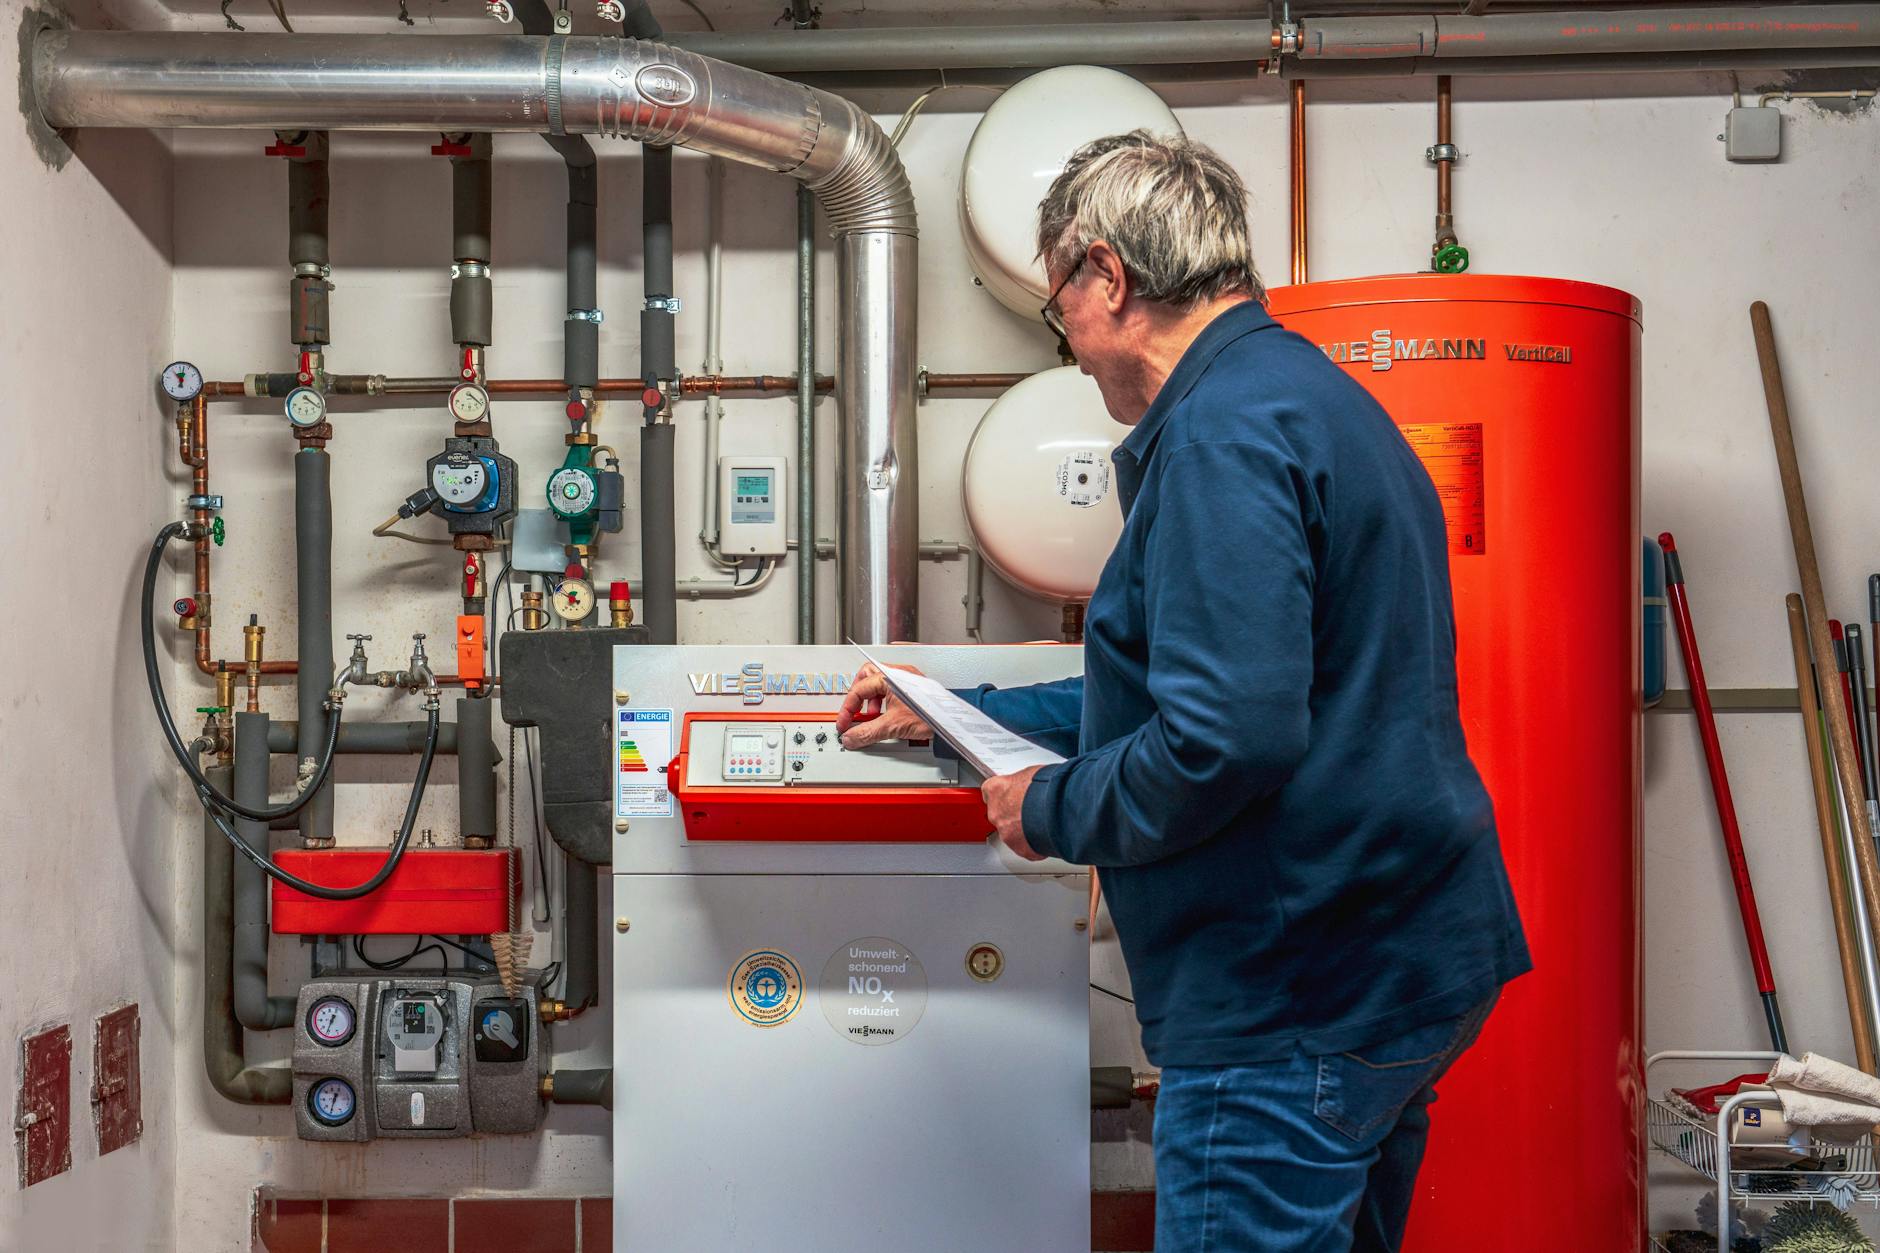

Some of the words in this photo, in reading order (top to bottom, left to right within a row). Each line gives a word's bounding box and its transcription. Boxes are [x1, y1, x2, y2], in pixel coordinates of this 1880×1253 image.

[1319, 330, 1486, 372] VIESSMANN
[1504, 343, 1572, 363] VertiCell
[849, 947, 900, 959] Umwelt-
[848, 961, 906, 973] schonend
[847, 1005, 900, 1017] reduziert
[848, 1025, 895, 1037] VIESSMANN
